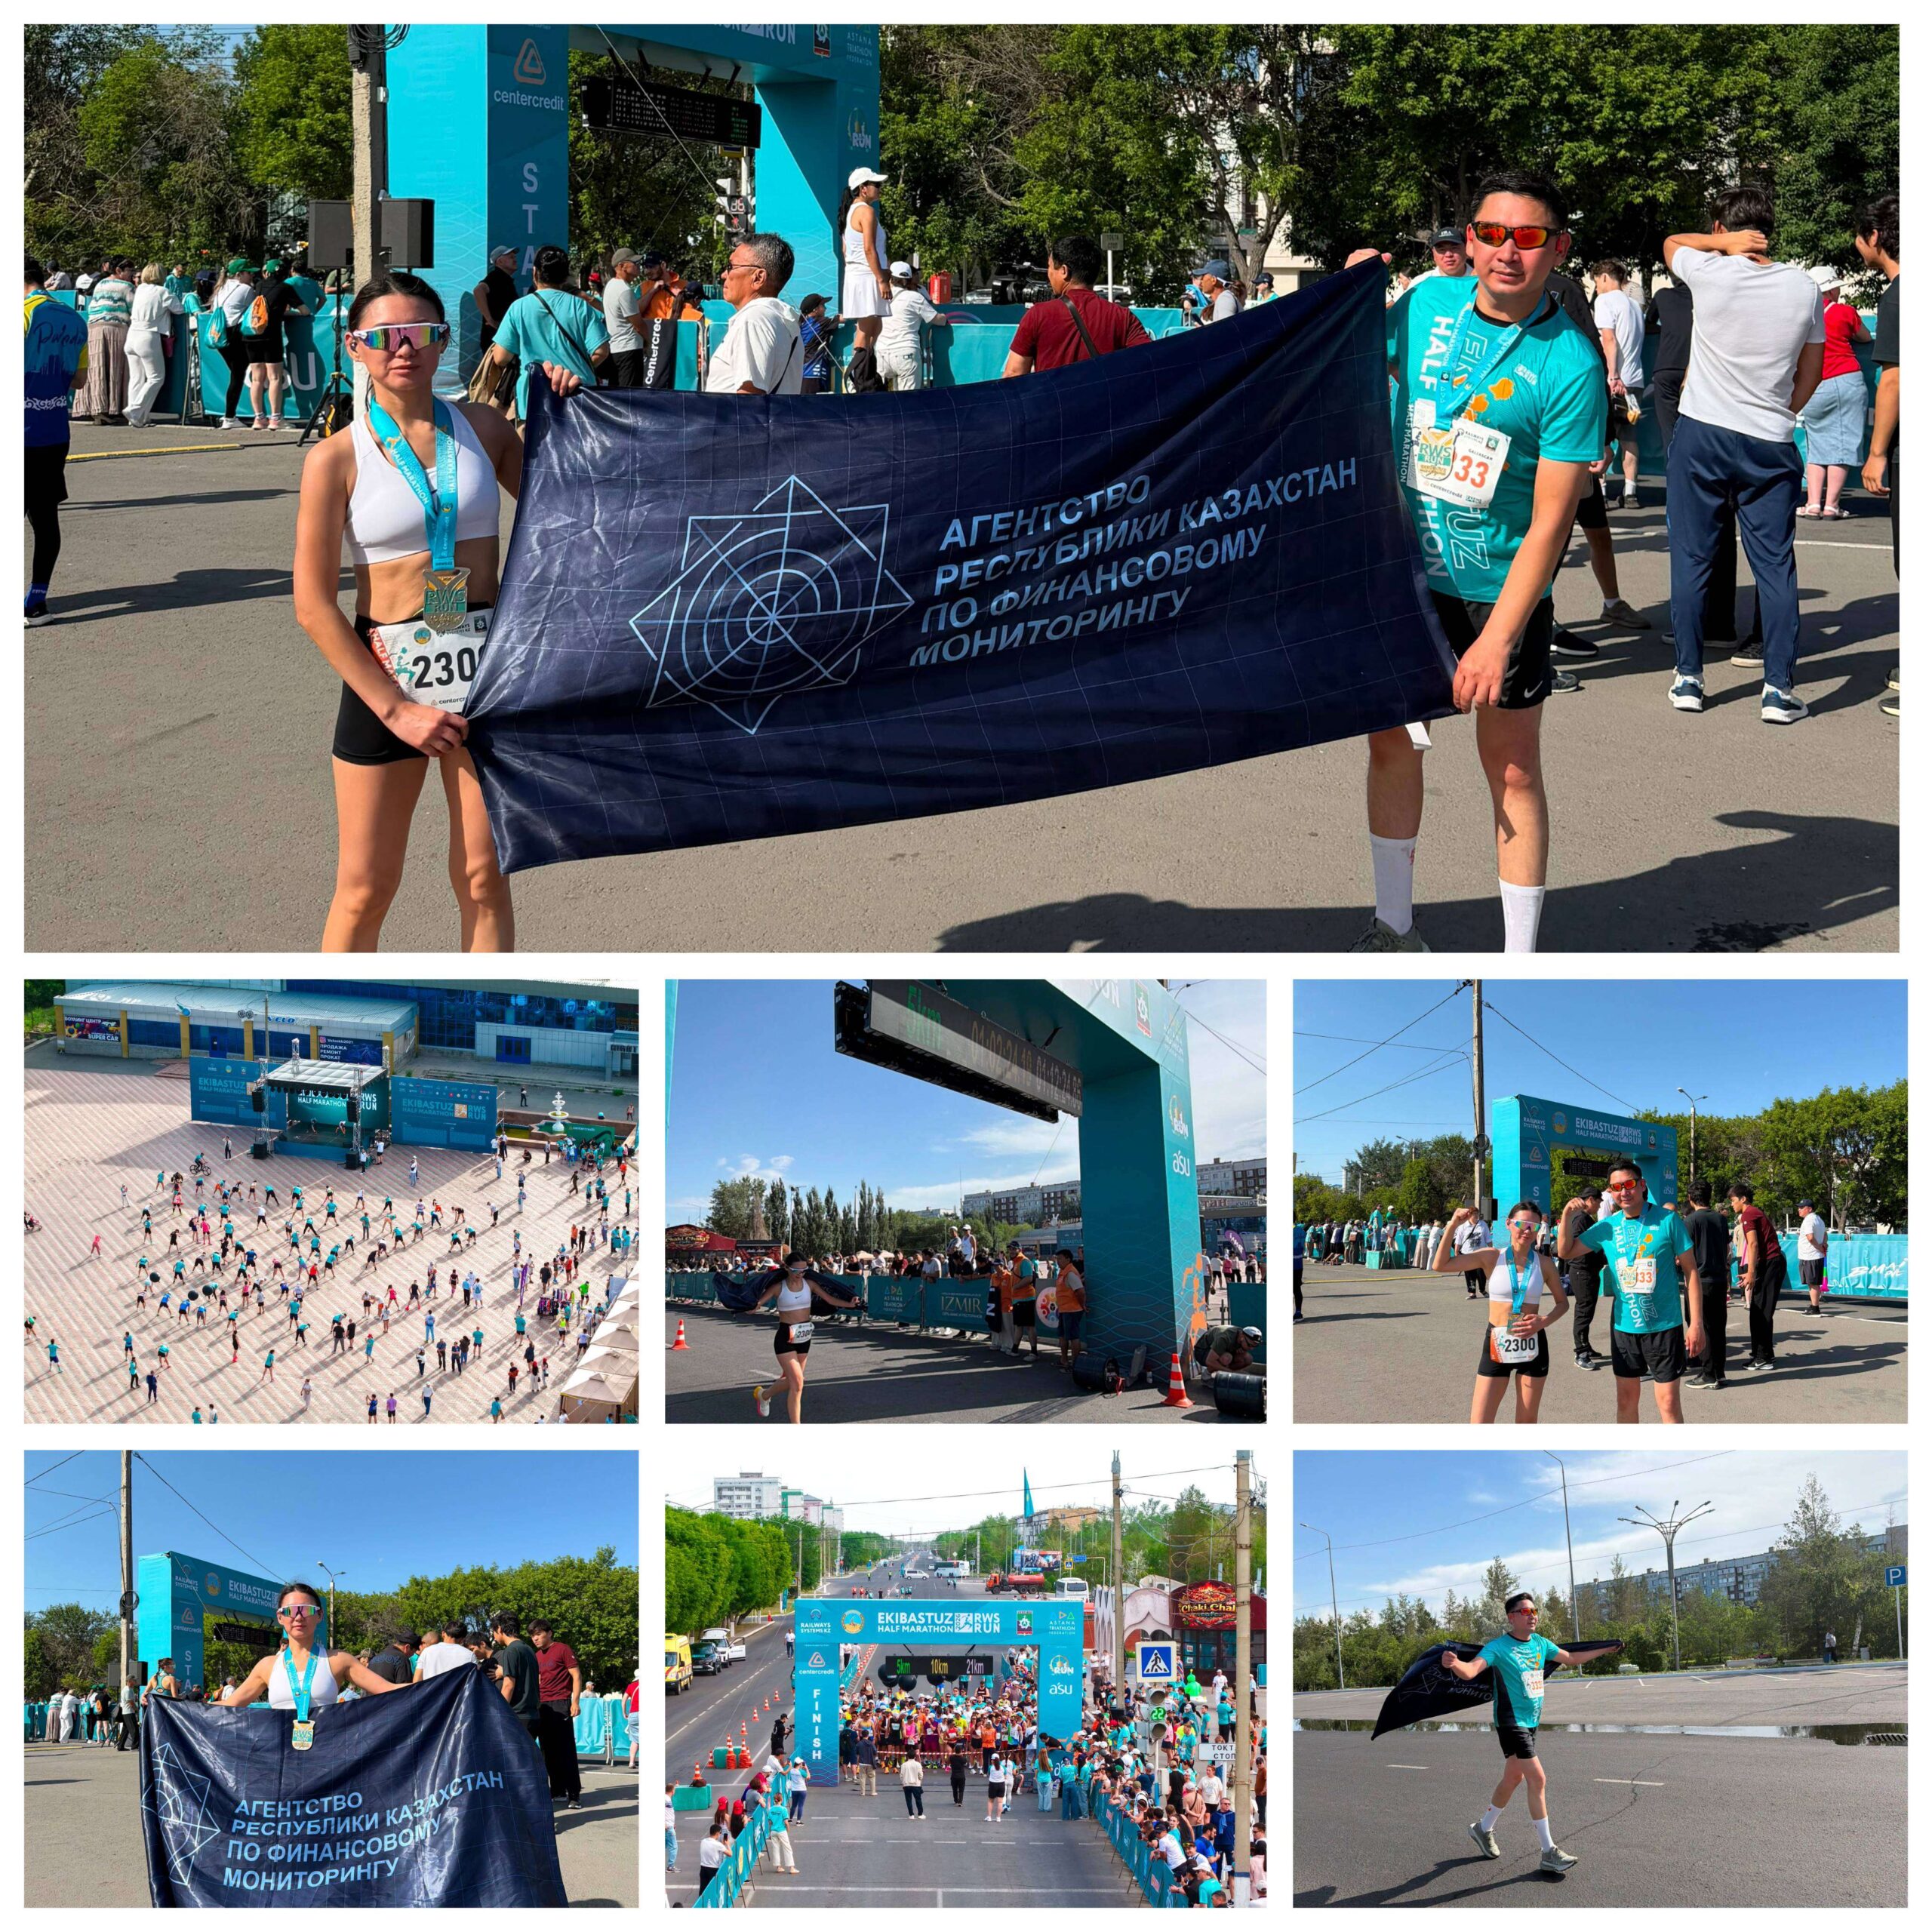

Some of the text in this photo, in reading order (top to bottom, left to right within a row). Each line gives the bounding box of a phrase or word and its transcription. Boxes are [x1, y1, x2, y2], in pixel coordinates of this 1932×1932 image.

[847, 32, 872, 45] ASTANA
[847, 43, 872, 57] TRIATHLON
[494, 89, 565, 111] centercredit
[851, 132, 872, 149] RUN
[1419, 315, 1455, 392] HALF
[1400, 429, 1412, 483] MARATHON
[1419, 443, 1452, 457] RWS
[1424, 454, 1444, 466] RUN
[391, 448, 430, 505] HALF MARATHON
[1454, 451, 1490, 489] 33
[940, 475, 1150, 551] АГЕНТСТВО
[934, 457, 1357, 596] РЕСПУБЛИКИ КАЗАХСТАН
[921, 524, 1267, 634] ПО ФИНАНСОВОМУ
[426, 589, 466, 605] RWS
[909, 586, 1192, 667] МОНИТОРИНГУ
[373, 635, 388, 663] HALF
[906, 985, 943, 1051] 5km
[198, 1077, 246, 1089] EKIBASTUZ
[214, 1087, 246, 1095] MARATHON
[361, 1092, 377, 1103] RWS
[313, 1098, 346, 1107] MARATHON
[360, 1102, 377, 1111] RUN
[402, 1098, 454, 1111] EKIBASTUZ
[468, 1105, 486, 1113] RWS
[418, 1109, 454, 1117] MARATHON
[468, 1112, 487, 1121] RUN
[1575, 1117, 1618, 1134] EKIBASTUZ
[1629, 1127, 1641, 1137] RWS
[1589, 1131, 1619, 1142] MARATHON
[1629, 1136, 1641, 1146] RUN
[1614, 1226, 1626, 1254] HALF
[941, 1296, 983, 1314] IZMIR
[1504, 1338, 1536, 1352] 2300
[175, 1575, 198, 1586] RAILWAYS
[1889, 1568, 1902, 1585] P
[229, 1580, 272, 1600] EKIBASTUZ
[229, 1592, 272, 1607] HALF MARATHON
[878, 1612, 953, 1624] EKIBASTUZ
[974, 1613, 1000, 1623] RWS
[173, 1625, 202, 1633] centercredit
[974, 1623, 1000, 1633] RUN
[897, 1659, 985, 1675] 5km 10km 21km
[1054, 1666, 1074, 1675] RUN
[1152, 1707, 1164, 1721] 22
[811, 1689, 822, 1760] FINISH
[232, 1770, 504, 1836] РЕСПУБЛИКИ КАЗАХСТАН
[234, 1792, 363, 1817] АГЕНТСТВО
[227, 1814, 442, 1863] ПО ФИНАНСОВОМУ
[223, 1857, 399, 1890] МОНИТОРИНГУ
